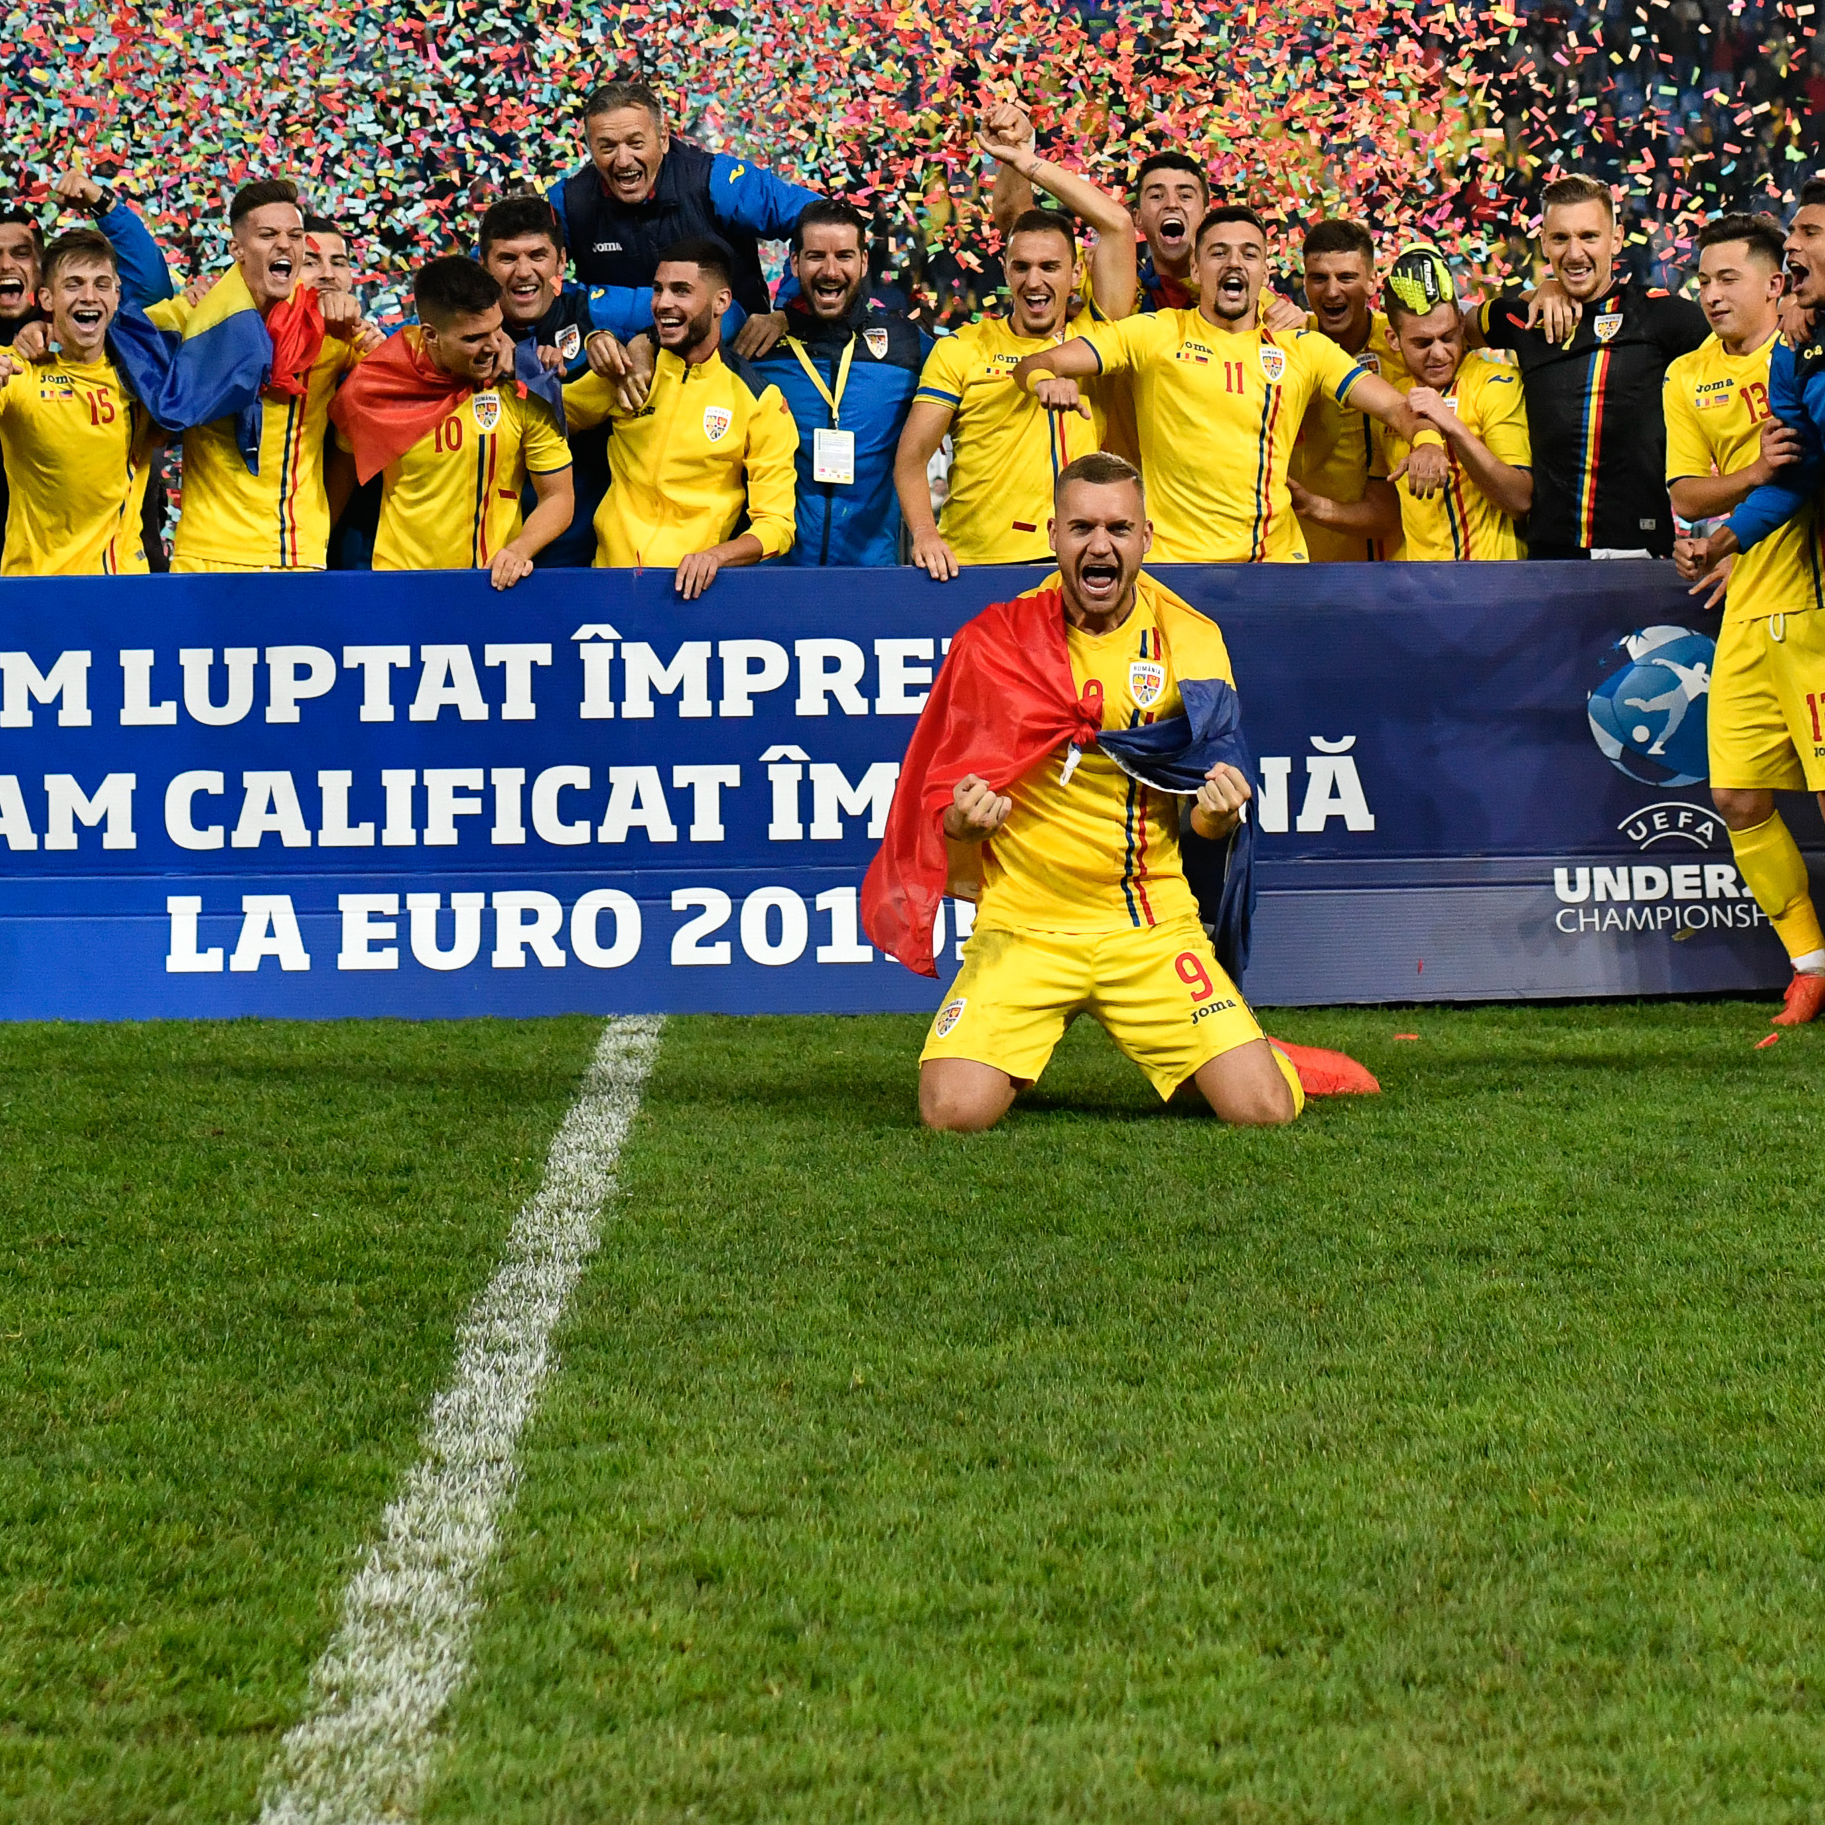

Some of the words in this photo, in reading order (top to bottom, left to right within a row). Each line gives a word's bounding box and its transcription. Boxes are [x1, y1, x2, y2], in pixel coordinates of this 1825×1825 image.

[1423, 259, 1437, 297] reusch
[1223, 361, 1245, 395] 11
[1695, 377, 1735, 394] Joma
[86, 387, 116, 426] 15
[1739, 381, 1774, 425] 13
[435, 415, 463, 453] 10
[119, 642, 553, 727] LUPTAT
[570, 623, 953, 720] ÎMPRE
[163, 764, 741, 851] CALIFICAT
[1626, 810, 1714, 842] UEFA
[1553, 863, 1755, 903] UNDER
[165, 894, 311, 974] LA
[336, 888, 643, 971] EURO
[670, 886, 977, 967] 201!
[1174, 951, 1214, 1003] 9
[1190, 999, 1237, 1025] Joma
